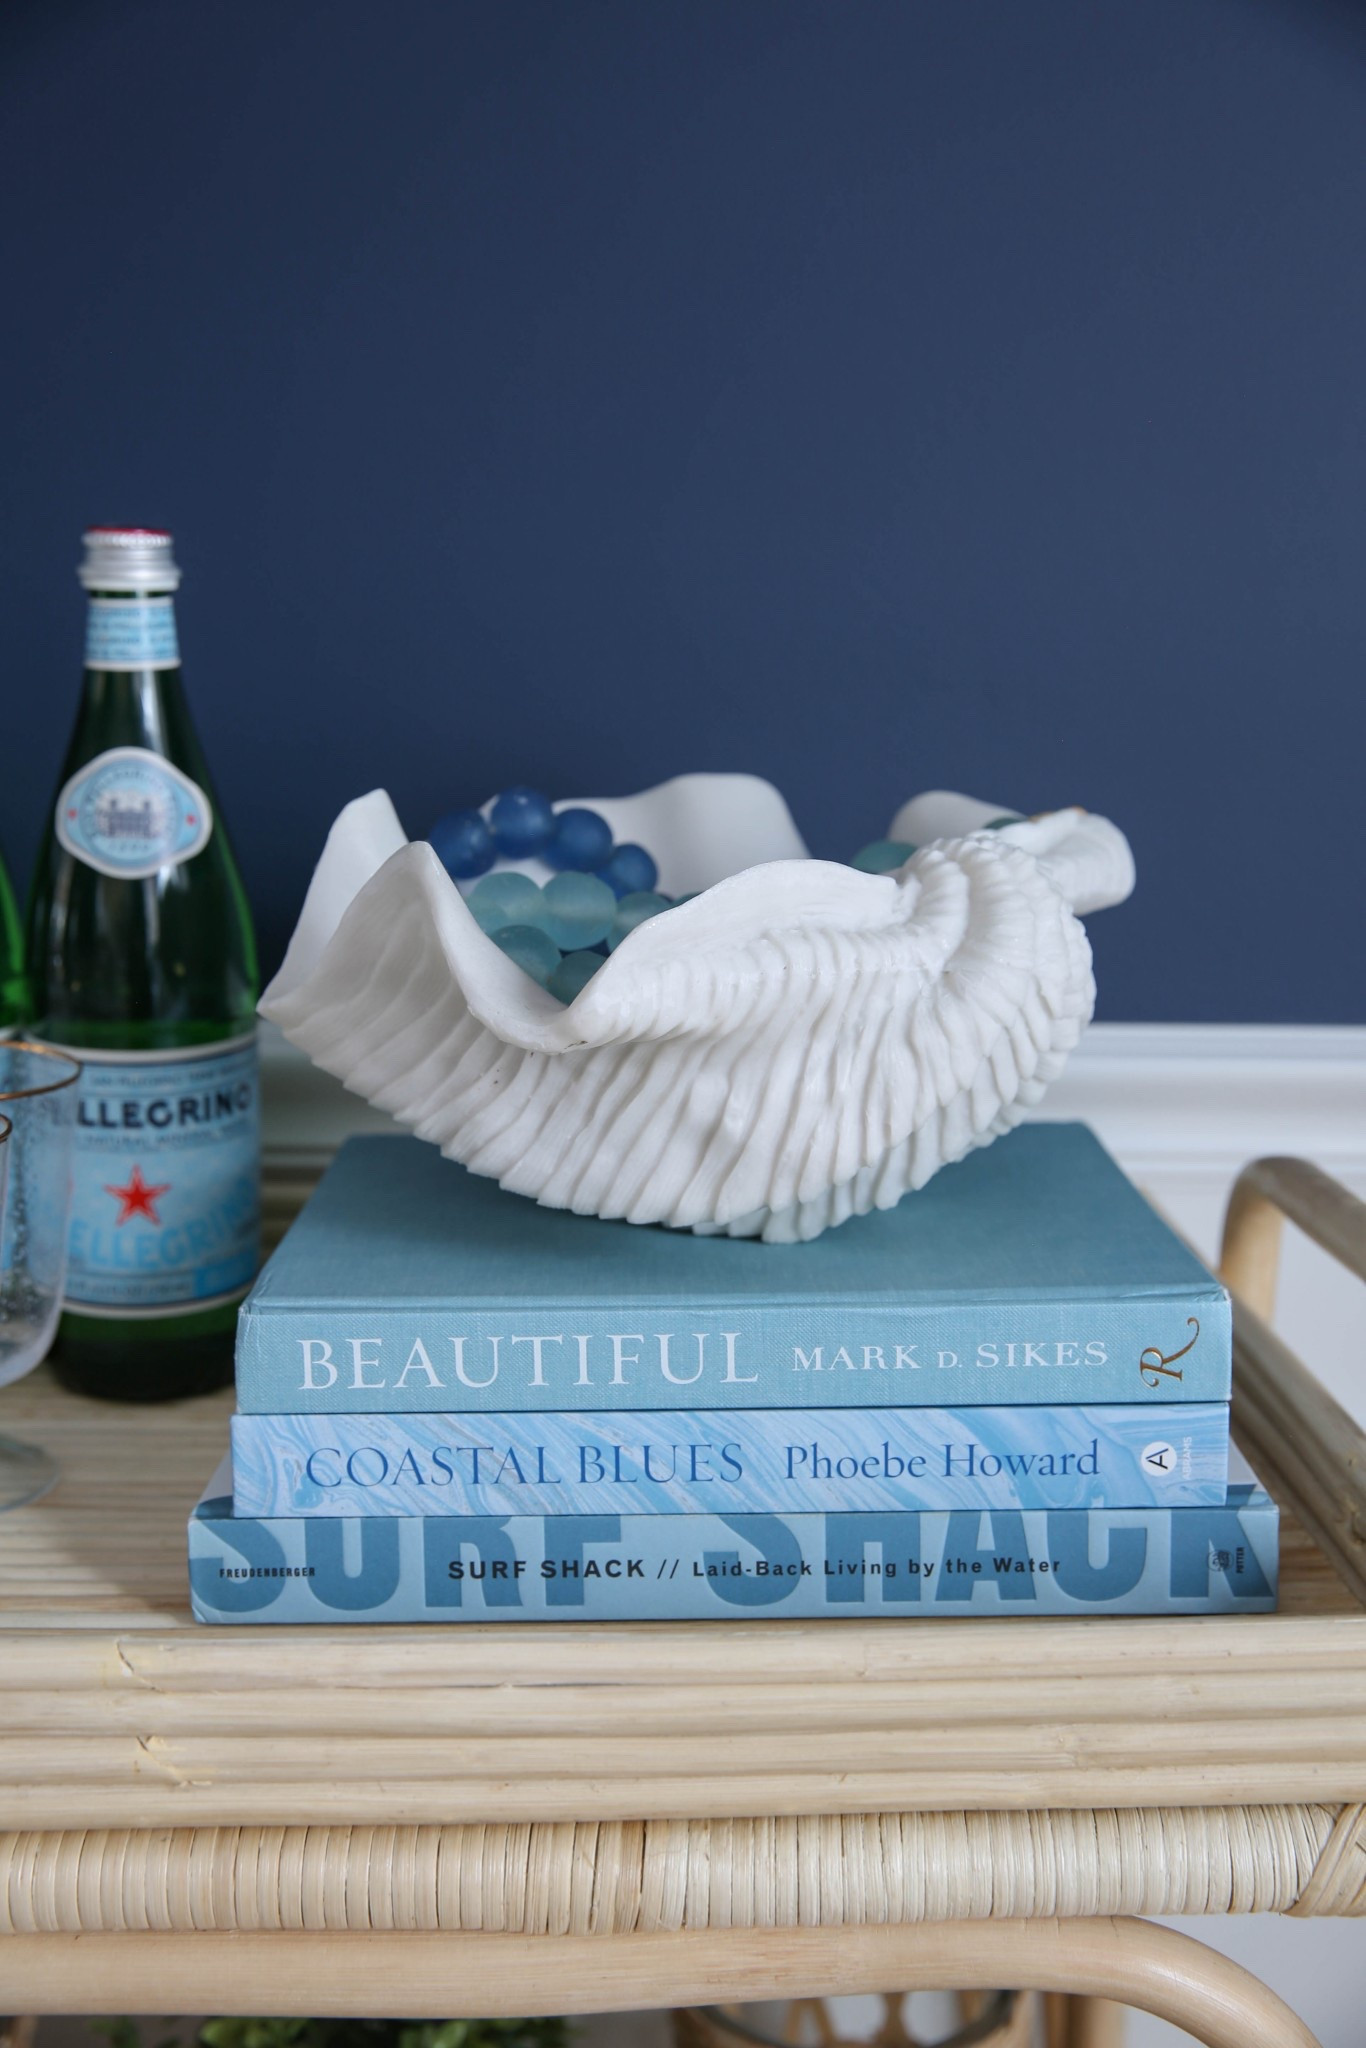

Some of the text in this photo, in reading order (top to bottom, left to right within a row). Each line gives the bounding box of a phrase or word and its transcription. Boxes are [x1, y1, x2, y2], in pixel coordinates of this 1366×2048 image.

[296, 1331, 759, 1390] BEAUTIFUL
[791, 1345, 922, 1373] MARK
[976, 1341, 1109, 1368] SIKES
[1139, 1316, 1200, 1388] R
[306, 1442, 743, 1488] COASTAL BLUES
[784, 1437, 1100, 1480] Phoebe Howard
[1182, 1436, 1193, 1481] ABRAMS
[219, 1567, 316, 1578] FREUDENBERGER
[448, 1560, 527, 1580] SURF
[540, 1559, 645, 1578] SHACK
[693, 1561, 813, 1577] Laid-Back
[824, 1559, 897, 1578] Living
[908, 1559, 935, 1578] by
[945, 1557, 982, 1574] the
[993, 1557, 1061, 1574] Water
